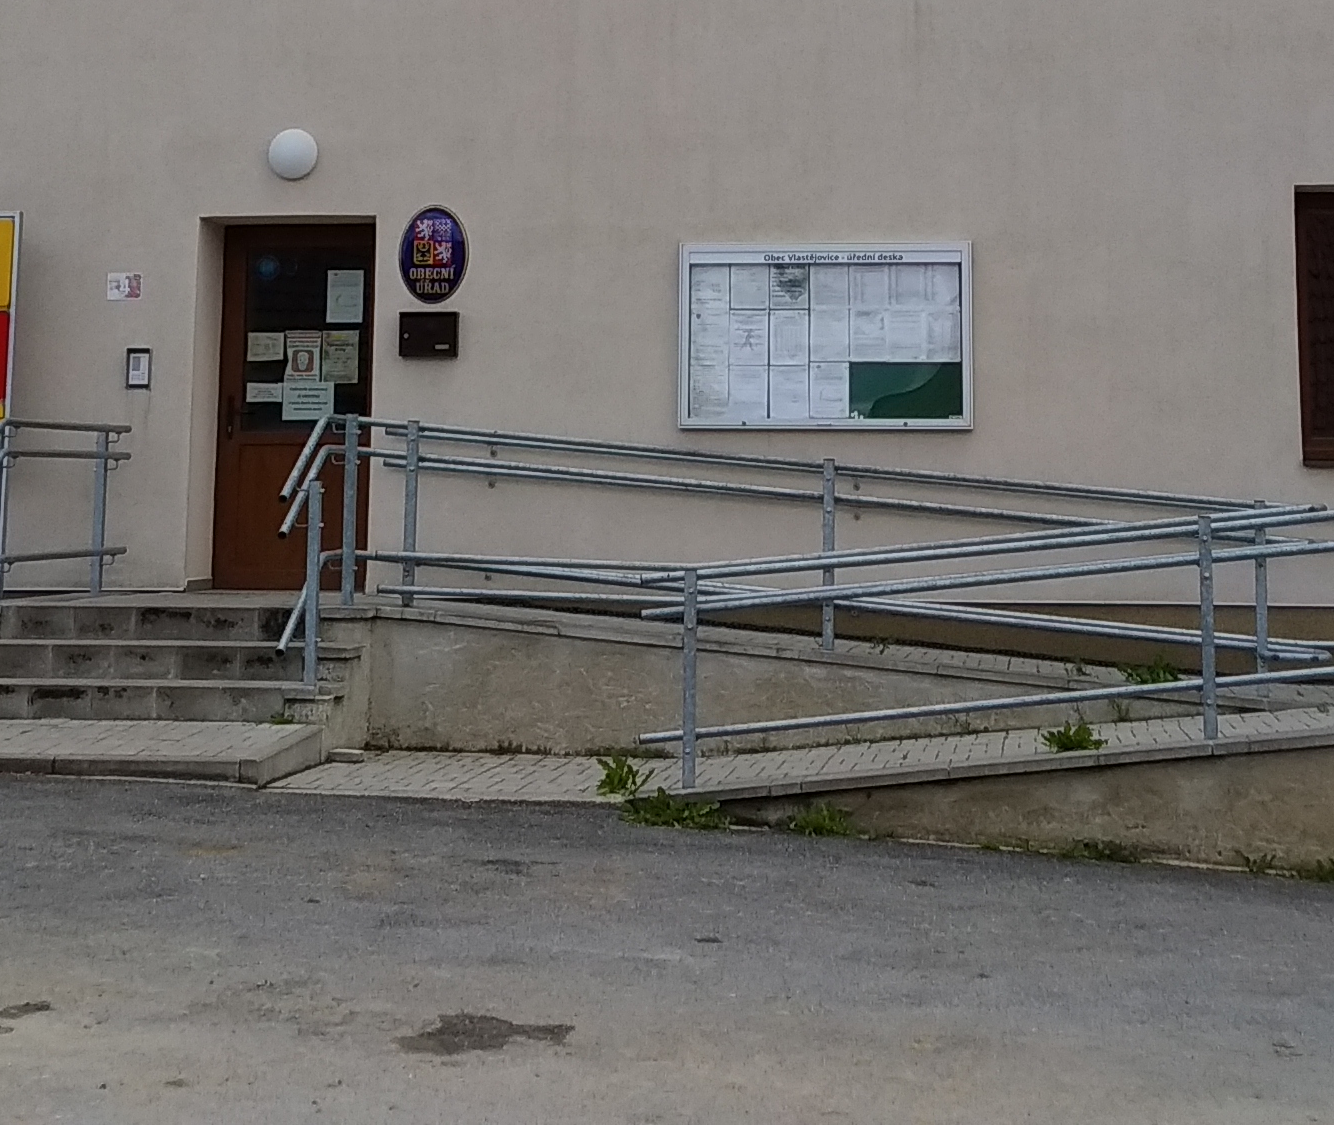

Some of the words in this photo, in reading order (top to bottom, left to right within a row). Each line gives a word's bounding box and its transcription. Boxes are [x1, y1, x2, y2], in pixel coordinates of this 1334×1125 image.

[763, 254, 786, 262] Obec
[787, 253, 840, 263] Vlastějovice
[846, 253, 876, 261] úřední
[877, 253, 904, 261] deska
[409, 265, 455, 279] OBECNÍ
[415, 279, 449, 293] ÚŘAD
